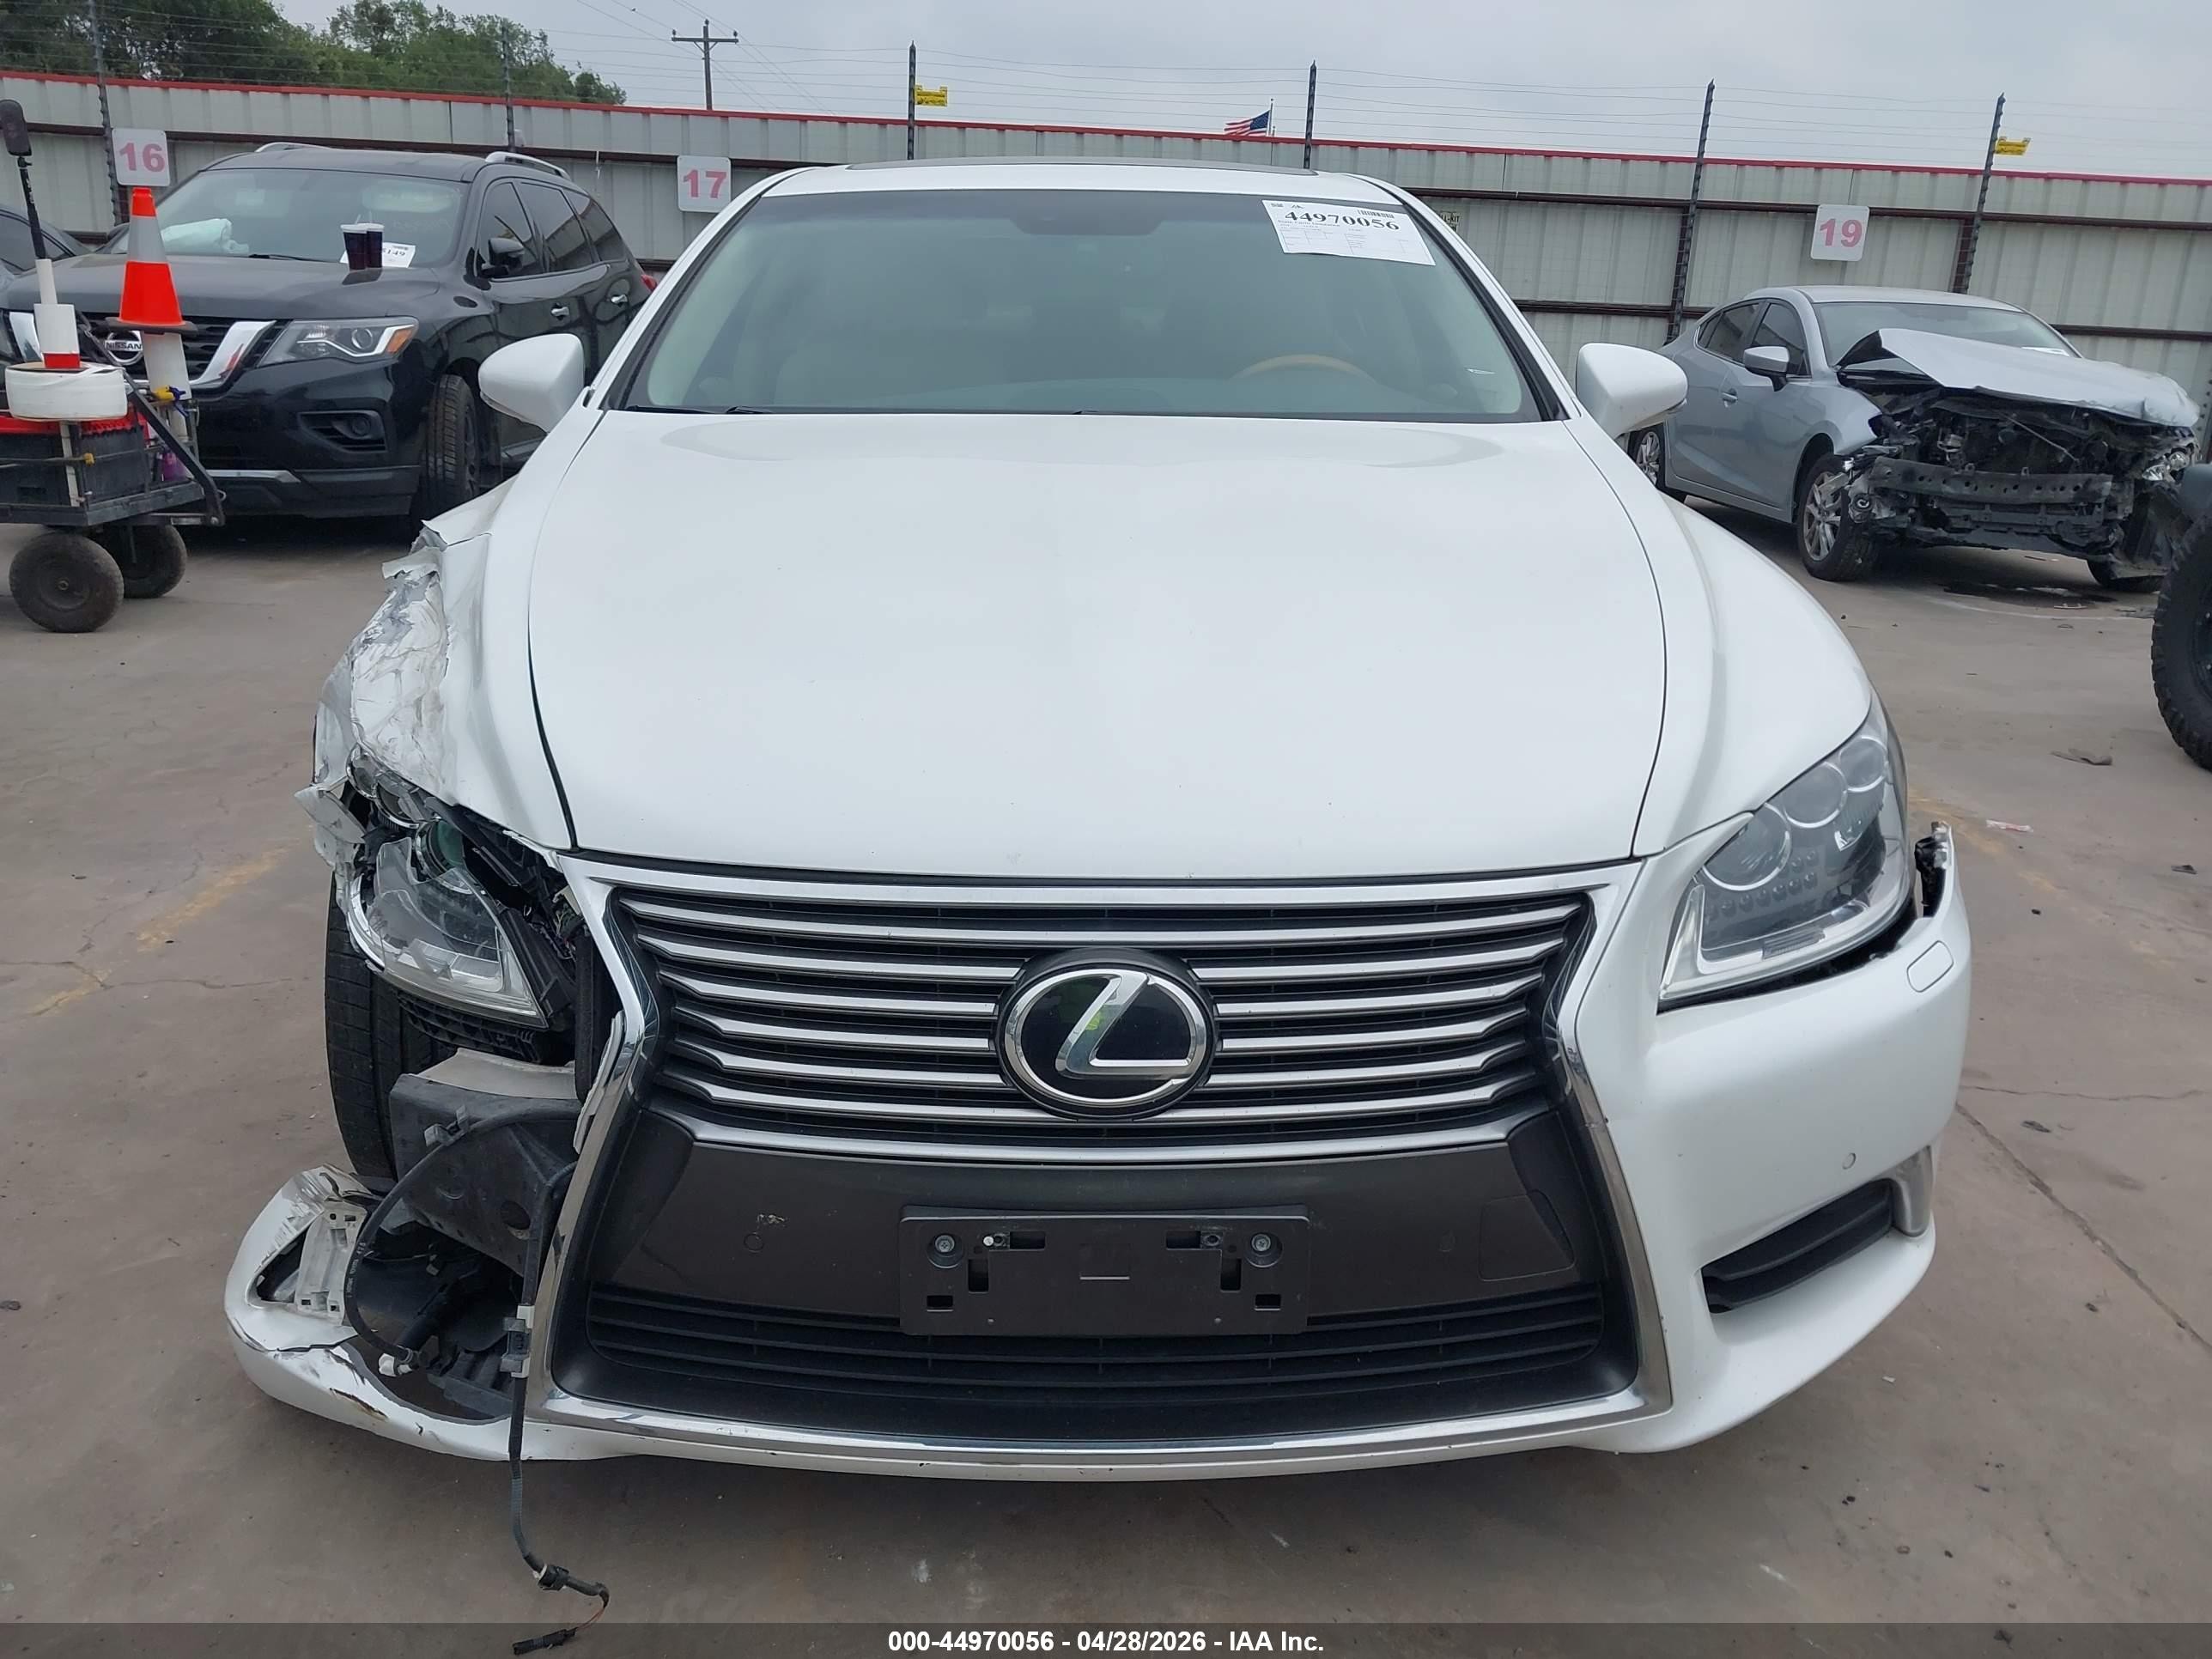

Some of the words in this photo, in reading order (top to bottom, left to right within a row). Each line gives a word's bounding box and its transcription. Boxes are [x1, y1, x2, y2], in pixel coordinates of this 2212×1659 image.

[118, 143, 166, 173] 16
[683, 169, 727, 199] 17
[1285, 211, 1400, 230] 44970056
[1820, 218, 1863, 248] 19
[106, 342, 143, 350] NISSAN
